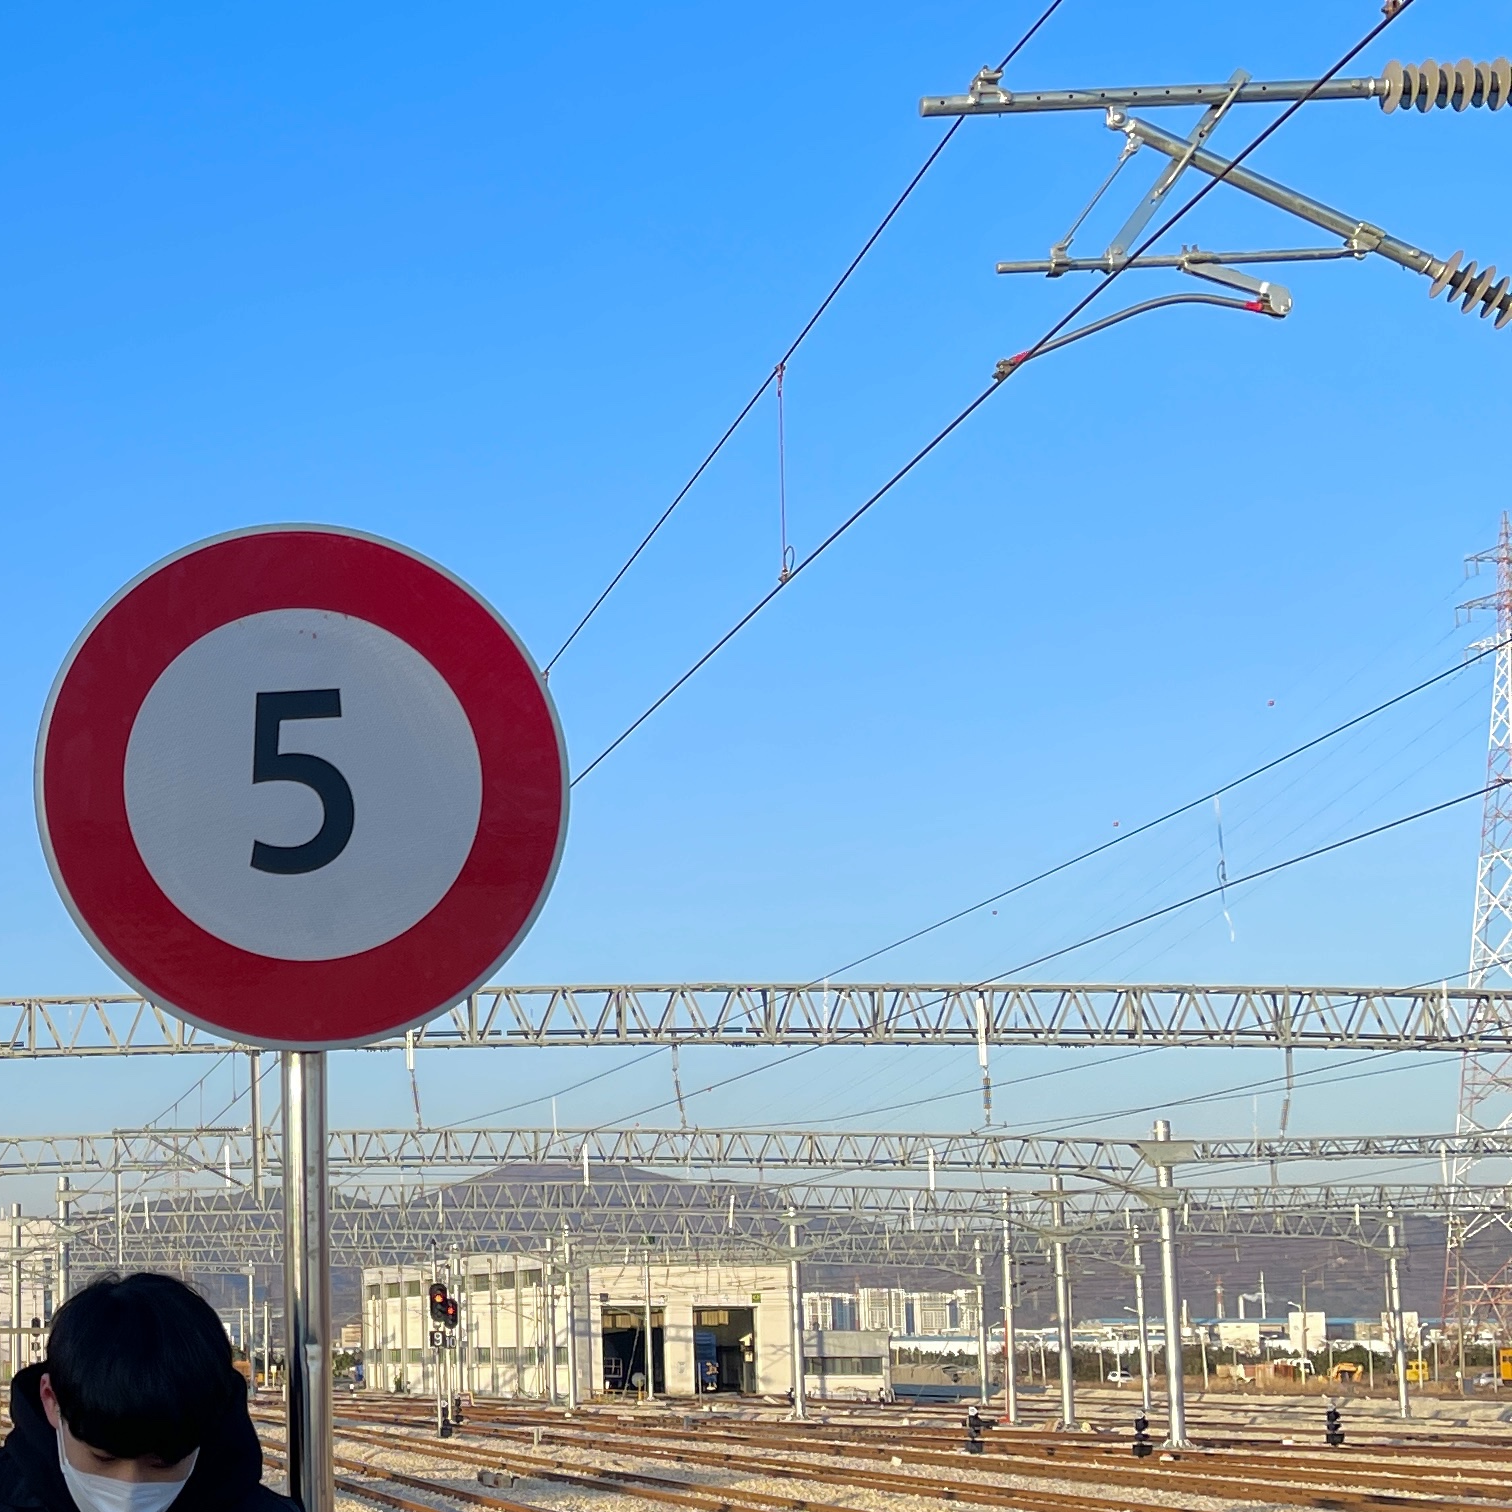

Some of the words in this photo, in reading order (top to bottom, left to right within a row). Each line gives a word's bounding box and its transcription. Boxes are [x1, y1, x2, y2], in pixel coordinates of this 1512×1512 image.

[250, 688, 354, 875] 5
[434, 1332, 443, 1346] 9
[446, 1337, 457, 1348] 10
